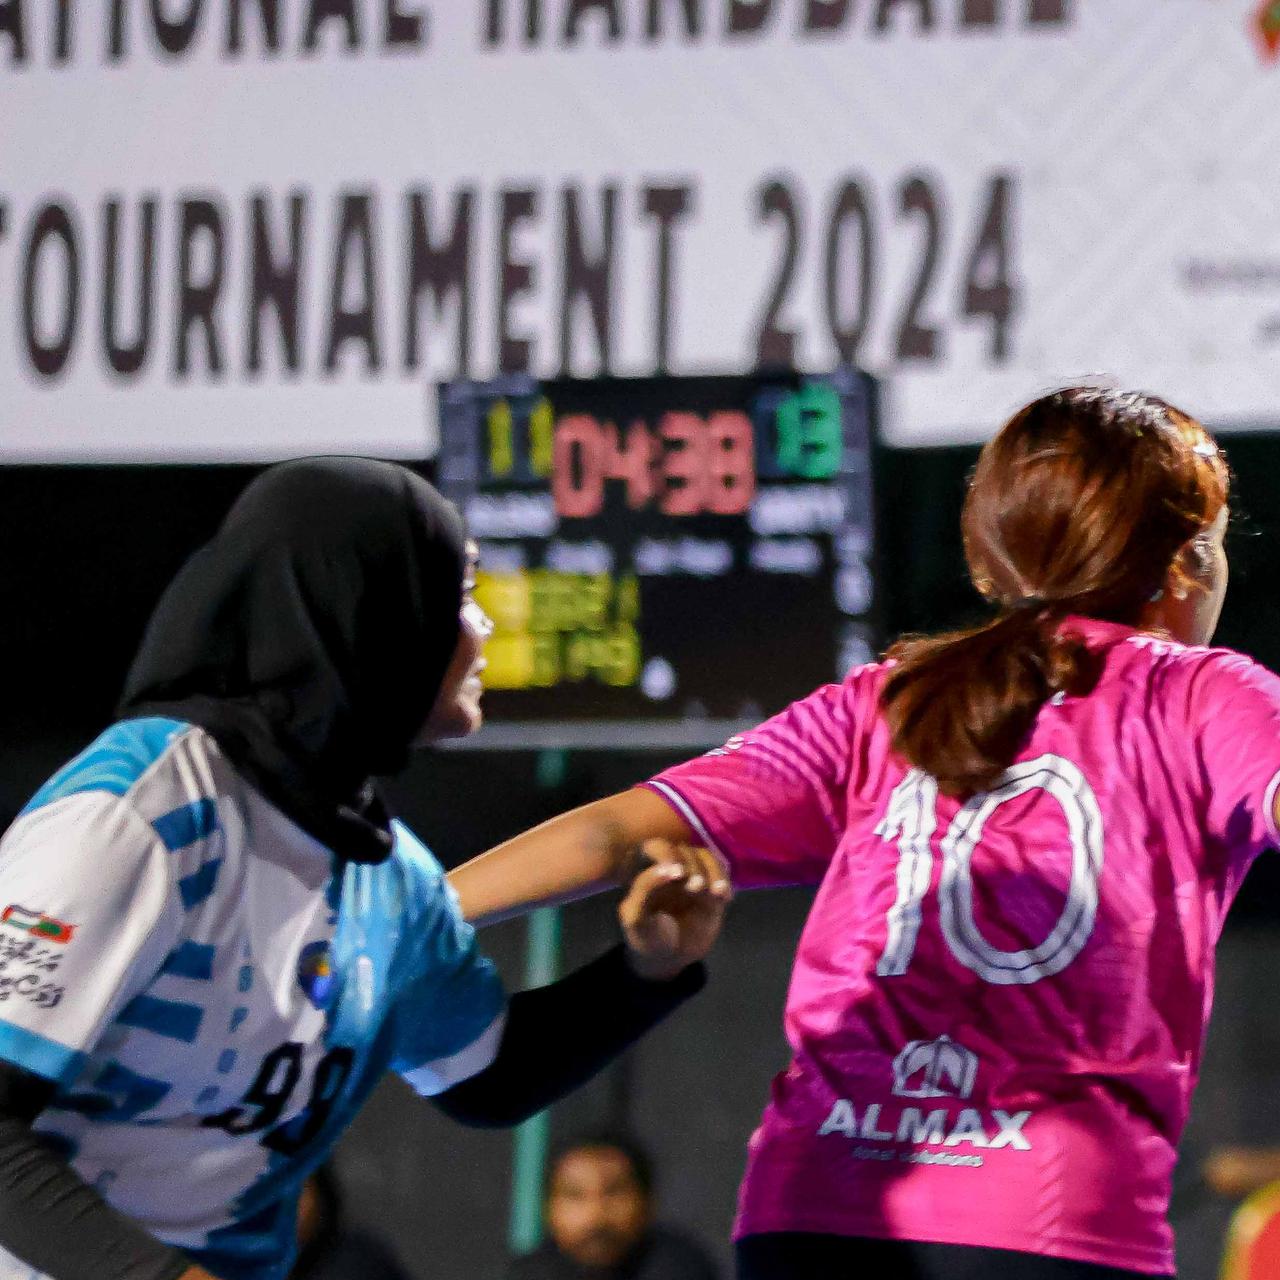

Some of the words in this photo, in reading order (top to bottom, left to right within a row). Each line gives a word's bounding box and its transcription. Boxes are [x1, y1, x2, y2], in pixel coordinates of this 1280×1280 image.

[0, 182, 698, 380] OURNAMENT
[752, 171, 1019, 370] 2024
[873, 752, 1104, 985] 10
[816, 1099, 1033, 1151] ALMAX
